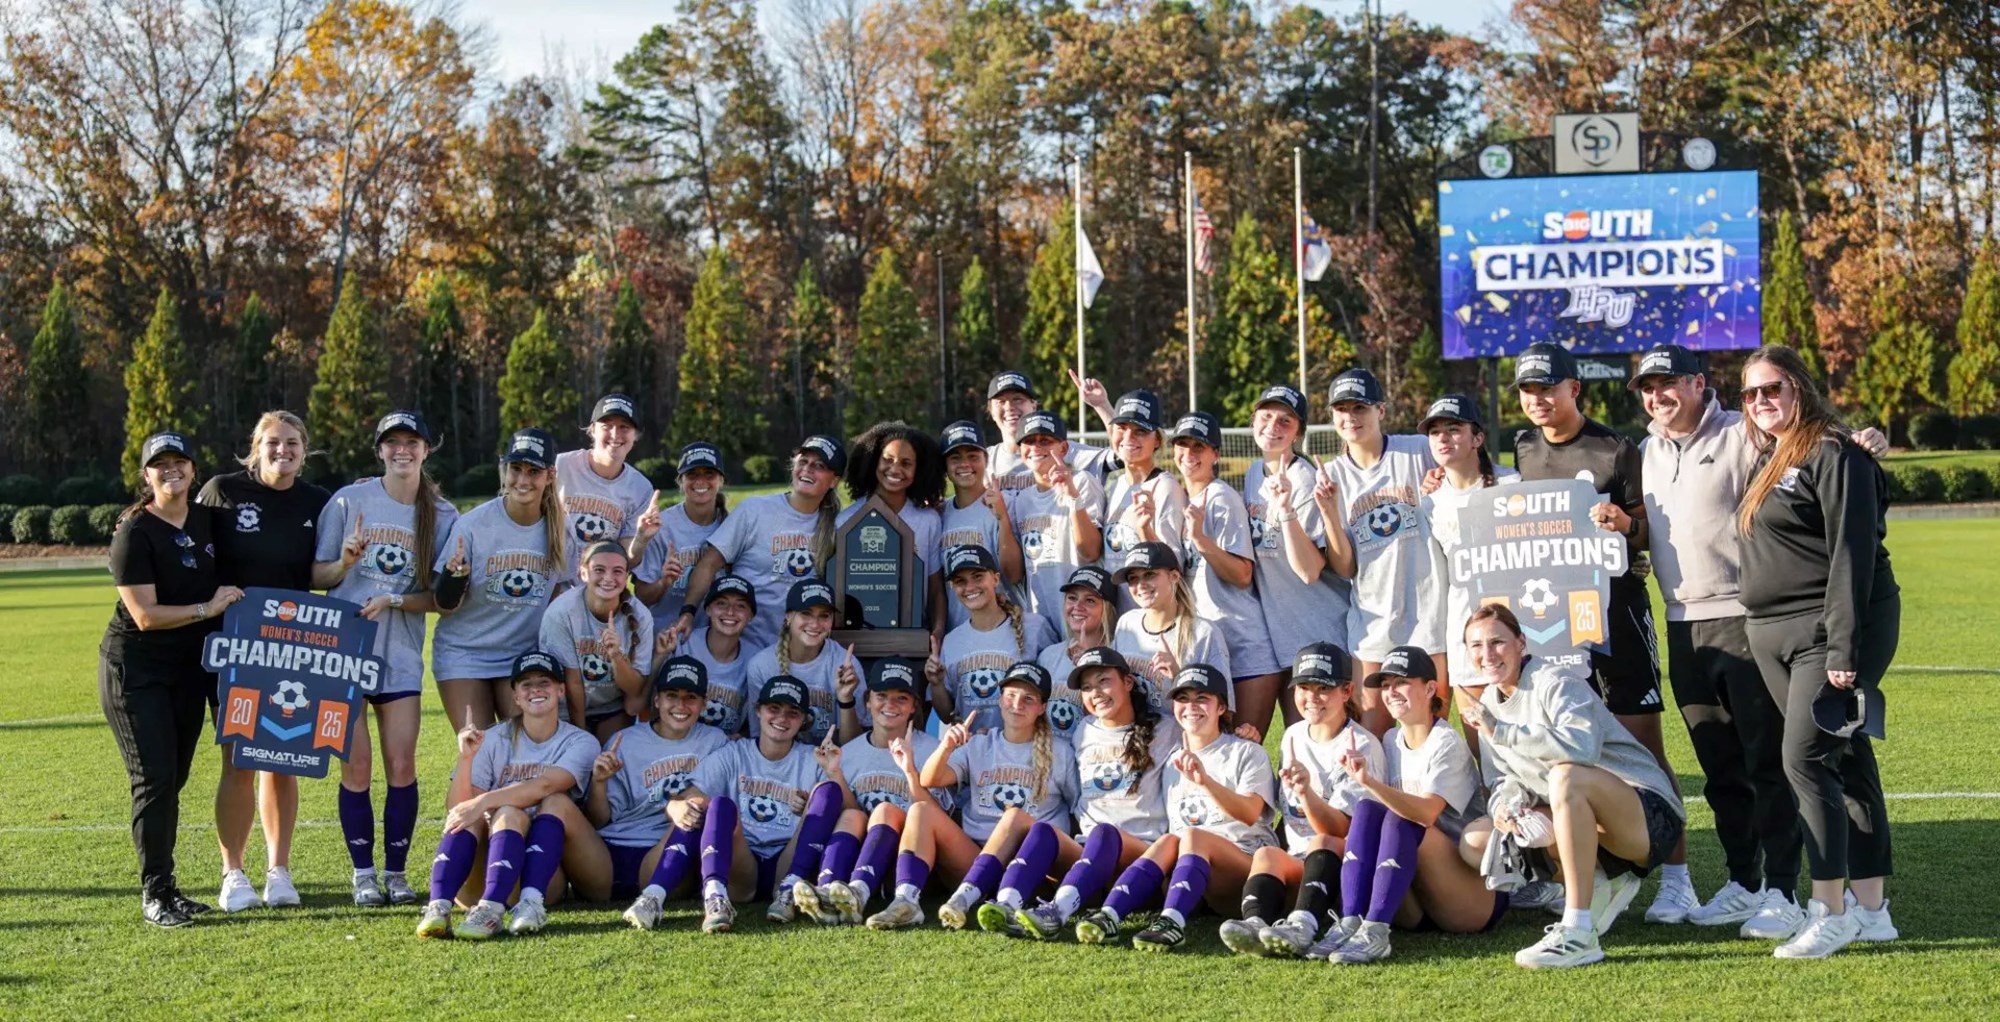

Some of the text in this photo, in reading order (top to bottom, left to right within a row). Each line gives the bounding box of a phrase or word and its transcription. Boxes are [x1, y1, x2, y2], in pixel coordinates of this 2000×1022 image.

[1484, 248, 1715, 281] CHAMPIONS
[1560, 285, 1636, 328] HPU
[1495, 519, 1573, 539] WOMEN'S SOCCER
[772, 558, 786, 574] 20
[850, 563, 896, 572] CHAMPION
[1454, 537, 1622, 582] CHAMPIONS
[1575, 602, 1597, 631] 25
[260, 624, 338, 648] WOMEN'S SOCCER
[208, 636, 380, 691] CHAMPIONS
[231, 697, 253, 725] 20
[321, 711, 342, 738] 25
[242, 746, 320, 766] SIGNATURE
